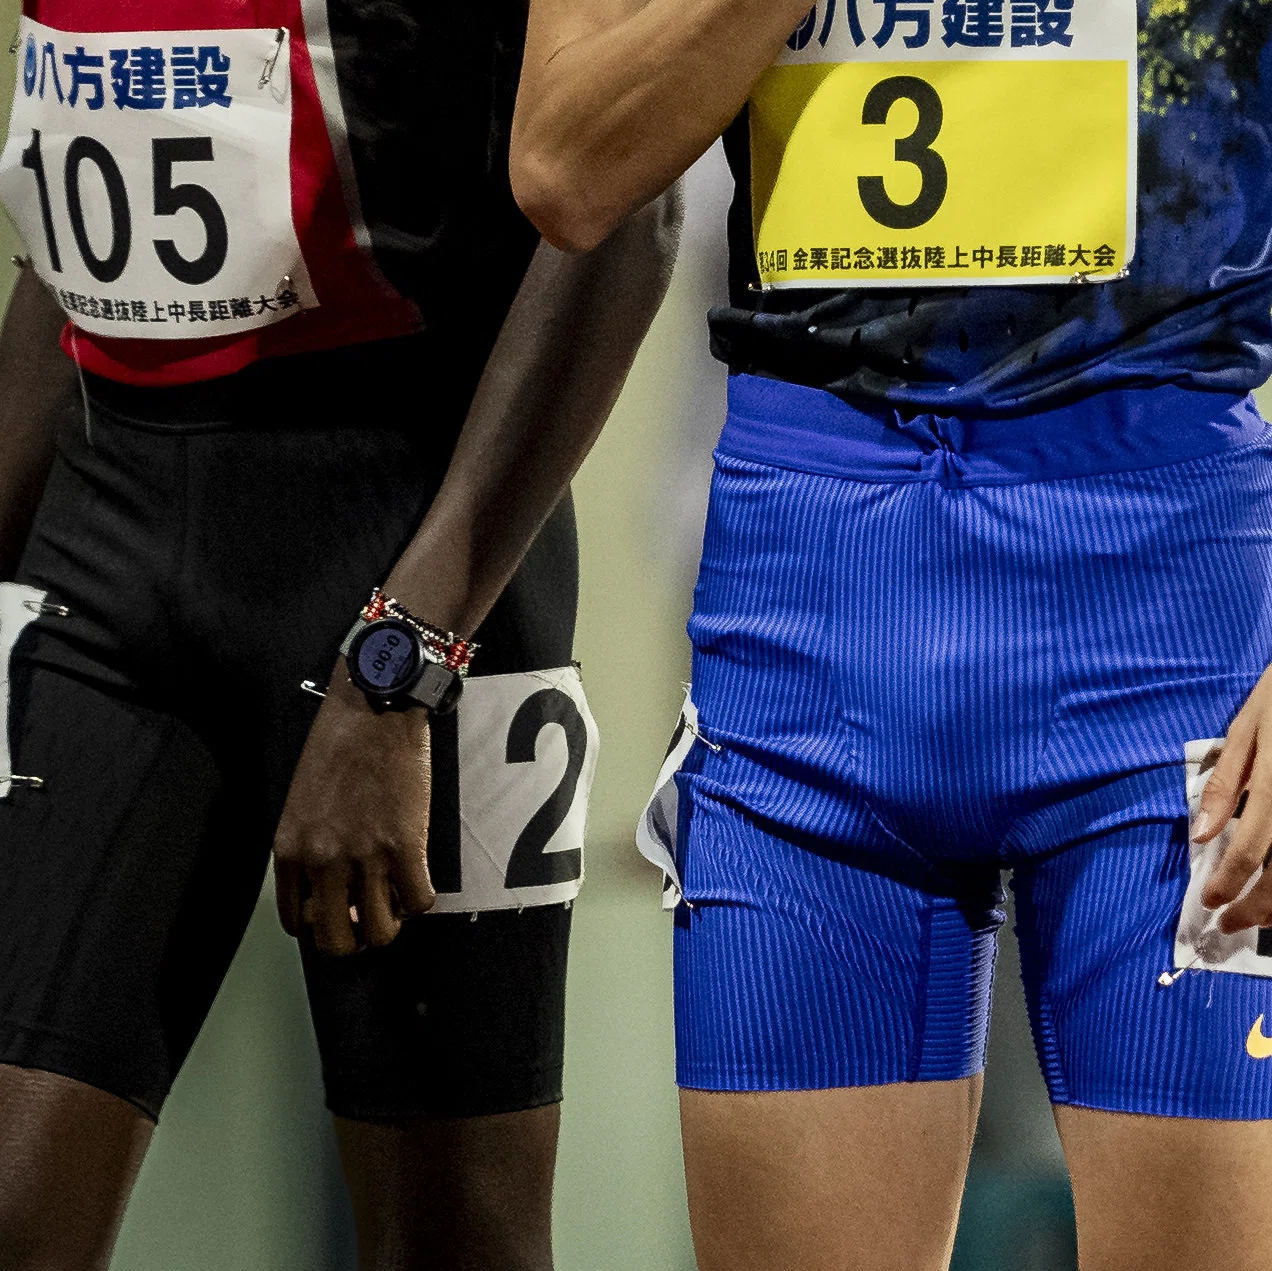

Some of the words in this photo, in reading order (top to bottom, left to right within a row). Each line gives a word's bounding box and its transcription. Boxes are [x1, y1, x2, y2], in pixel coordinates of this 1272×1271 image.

[38, 42, 233, 110] 八方建設
[22, 128, 228, 285] 105
[857, 75, 949, 230] 3
[793, 244, 1117, 271] 金栗記念選抜陸上中長距離大会
